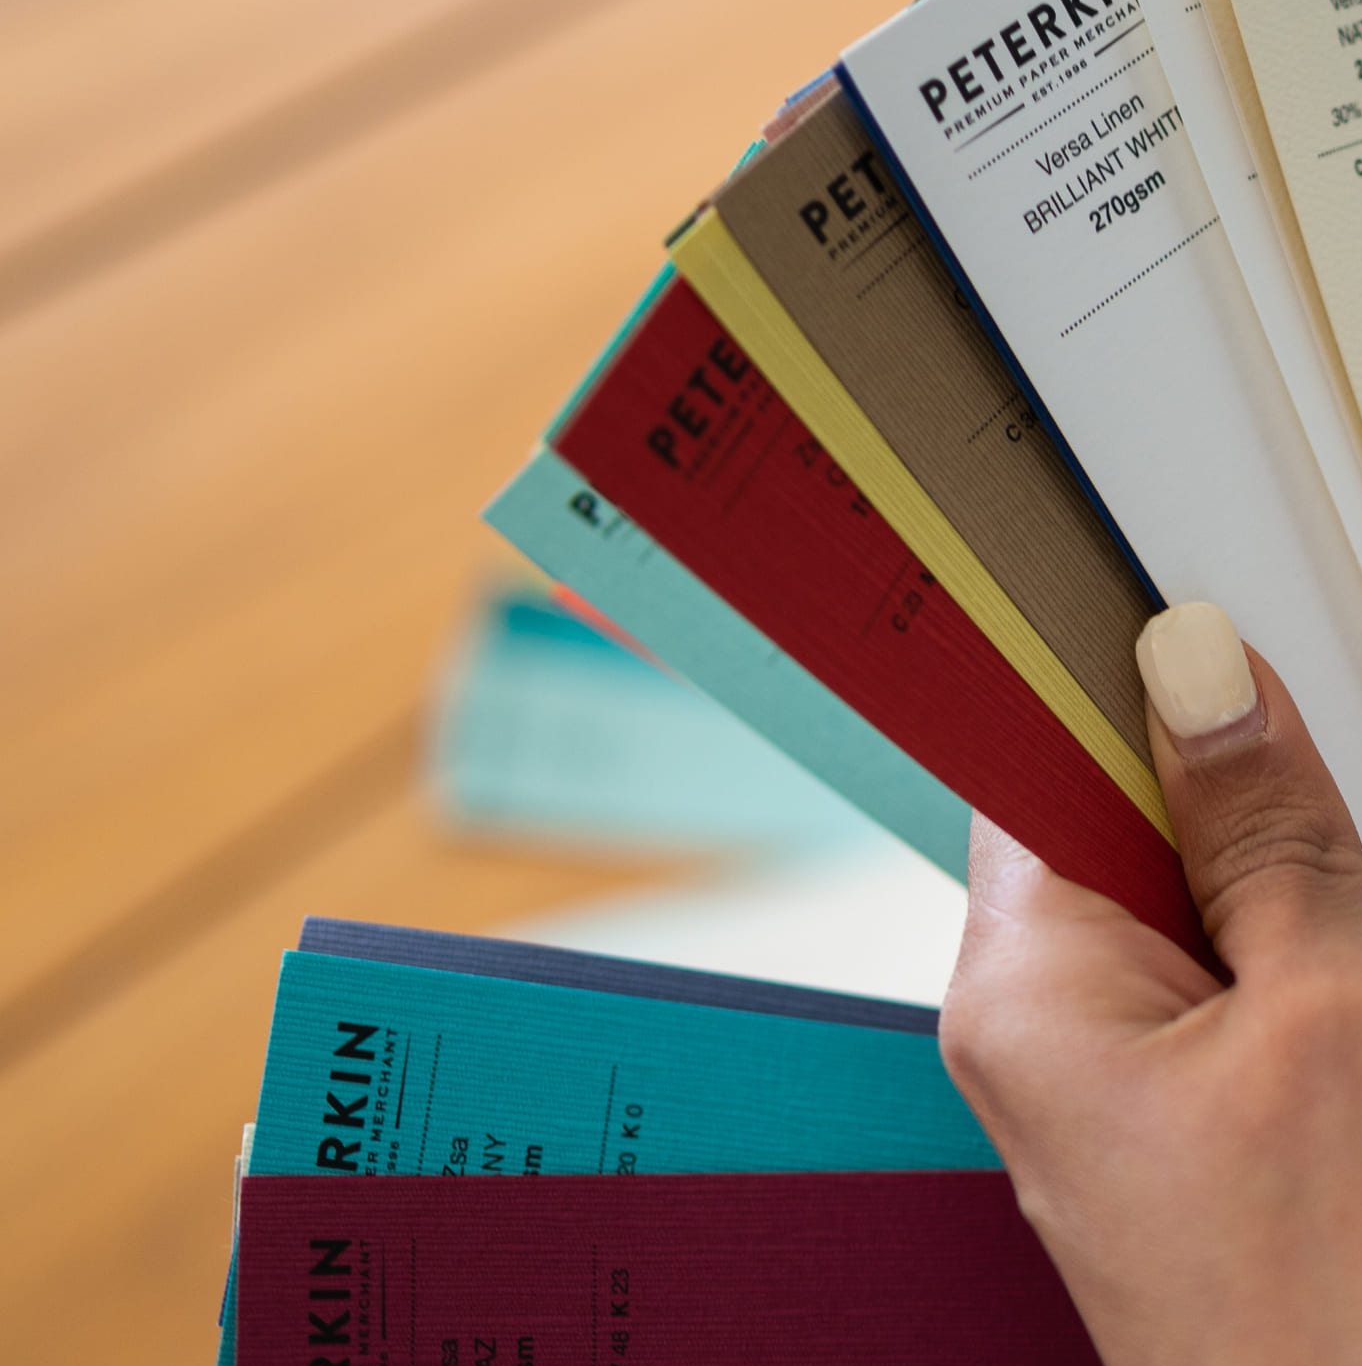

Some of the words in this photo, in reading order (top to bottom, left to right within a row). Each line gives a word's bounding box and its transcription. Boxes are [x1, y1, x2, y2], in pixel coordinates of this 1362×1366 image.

[944, 86, 1014, 139] PREMIUM
[1019, 47, 1070, 87] PAPER
[1331, 101, 1362, 128] 30%
[1023, 147, 1124, 234] BRILLIANT
[1125, 105, 1184, 159] WHIT
[1035, 132, 1093, 176] Versa
[1090, 94, 1144, 139] Linen
[1089, 170, 1166, 233] 270gsm
[370, 1027, 398, 1142] MERCHANT
[359, 1239, 371, 1355] MERCHANT
[611, 1268, 629, 1295] 23
[611, 1301, 628, 1317] K
